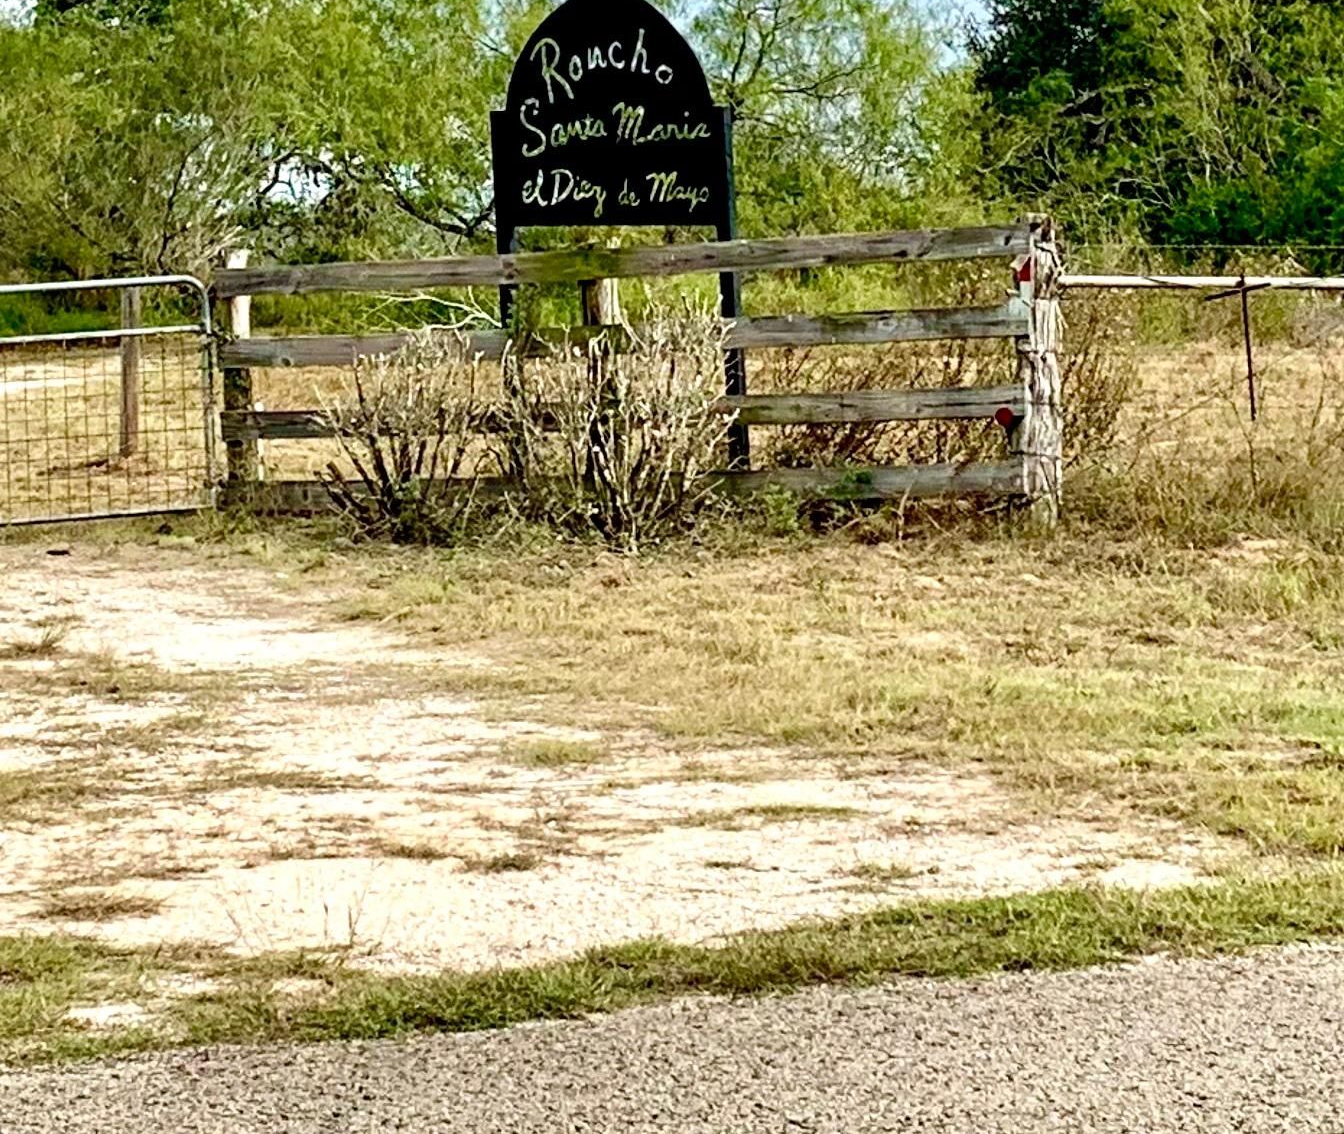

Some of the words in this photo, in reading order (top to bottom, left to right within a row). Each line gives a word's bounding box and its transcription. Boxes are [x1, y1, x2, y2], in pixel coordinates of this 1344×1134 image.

[520, 98, 607, 157] Santa
[612, 102, 711, 145] Maria
[522, 169, 547, 207] el
[618, 178, 641, 206] de
[645, 171, 709, 213] Mayo
